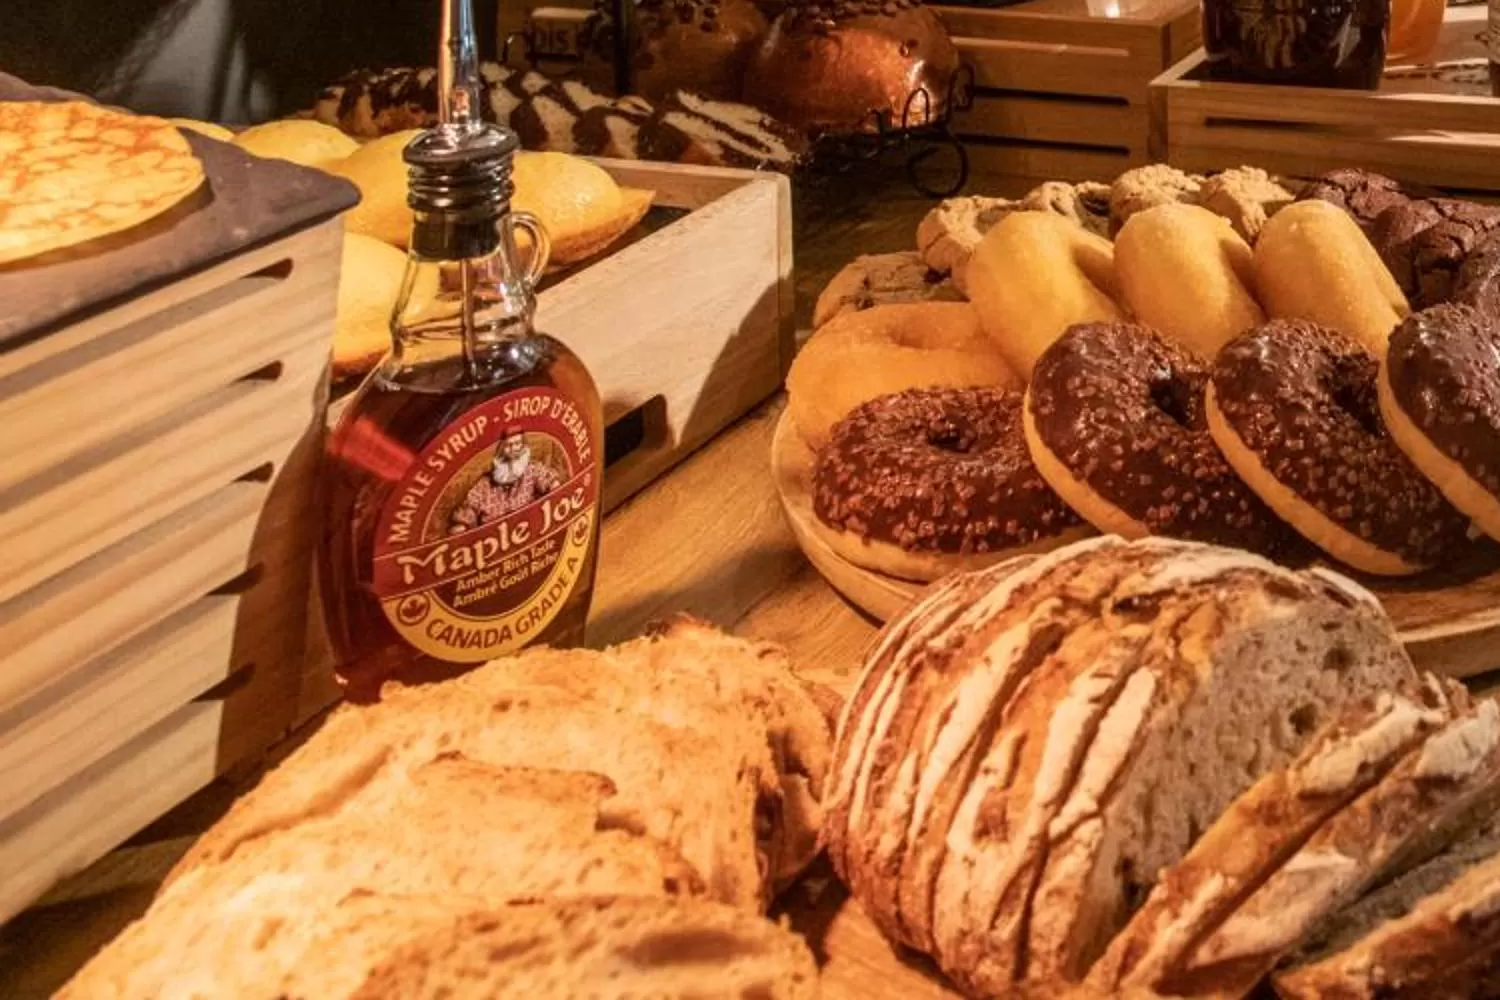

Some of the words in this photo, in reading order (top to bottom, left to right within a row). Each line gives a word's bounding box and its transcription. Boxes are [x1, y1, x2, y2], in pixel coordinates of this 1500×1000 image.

[388, 470, 435, 543] MAPLE
[427, 416, 487, 472] SYRUP
[503, 395, 551, 422] SIROP
[397, 520, 532, 584] Maple
[540, 487, 585, 535] Joe
[456, 568, 500, 593] Amber
[503, 552, 529, 574] Rich
[425, 617, 513, 649] CANADA
[515, 577, 570, 635] GRADE
[566, 557, 579, 574] A
